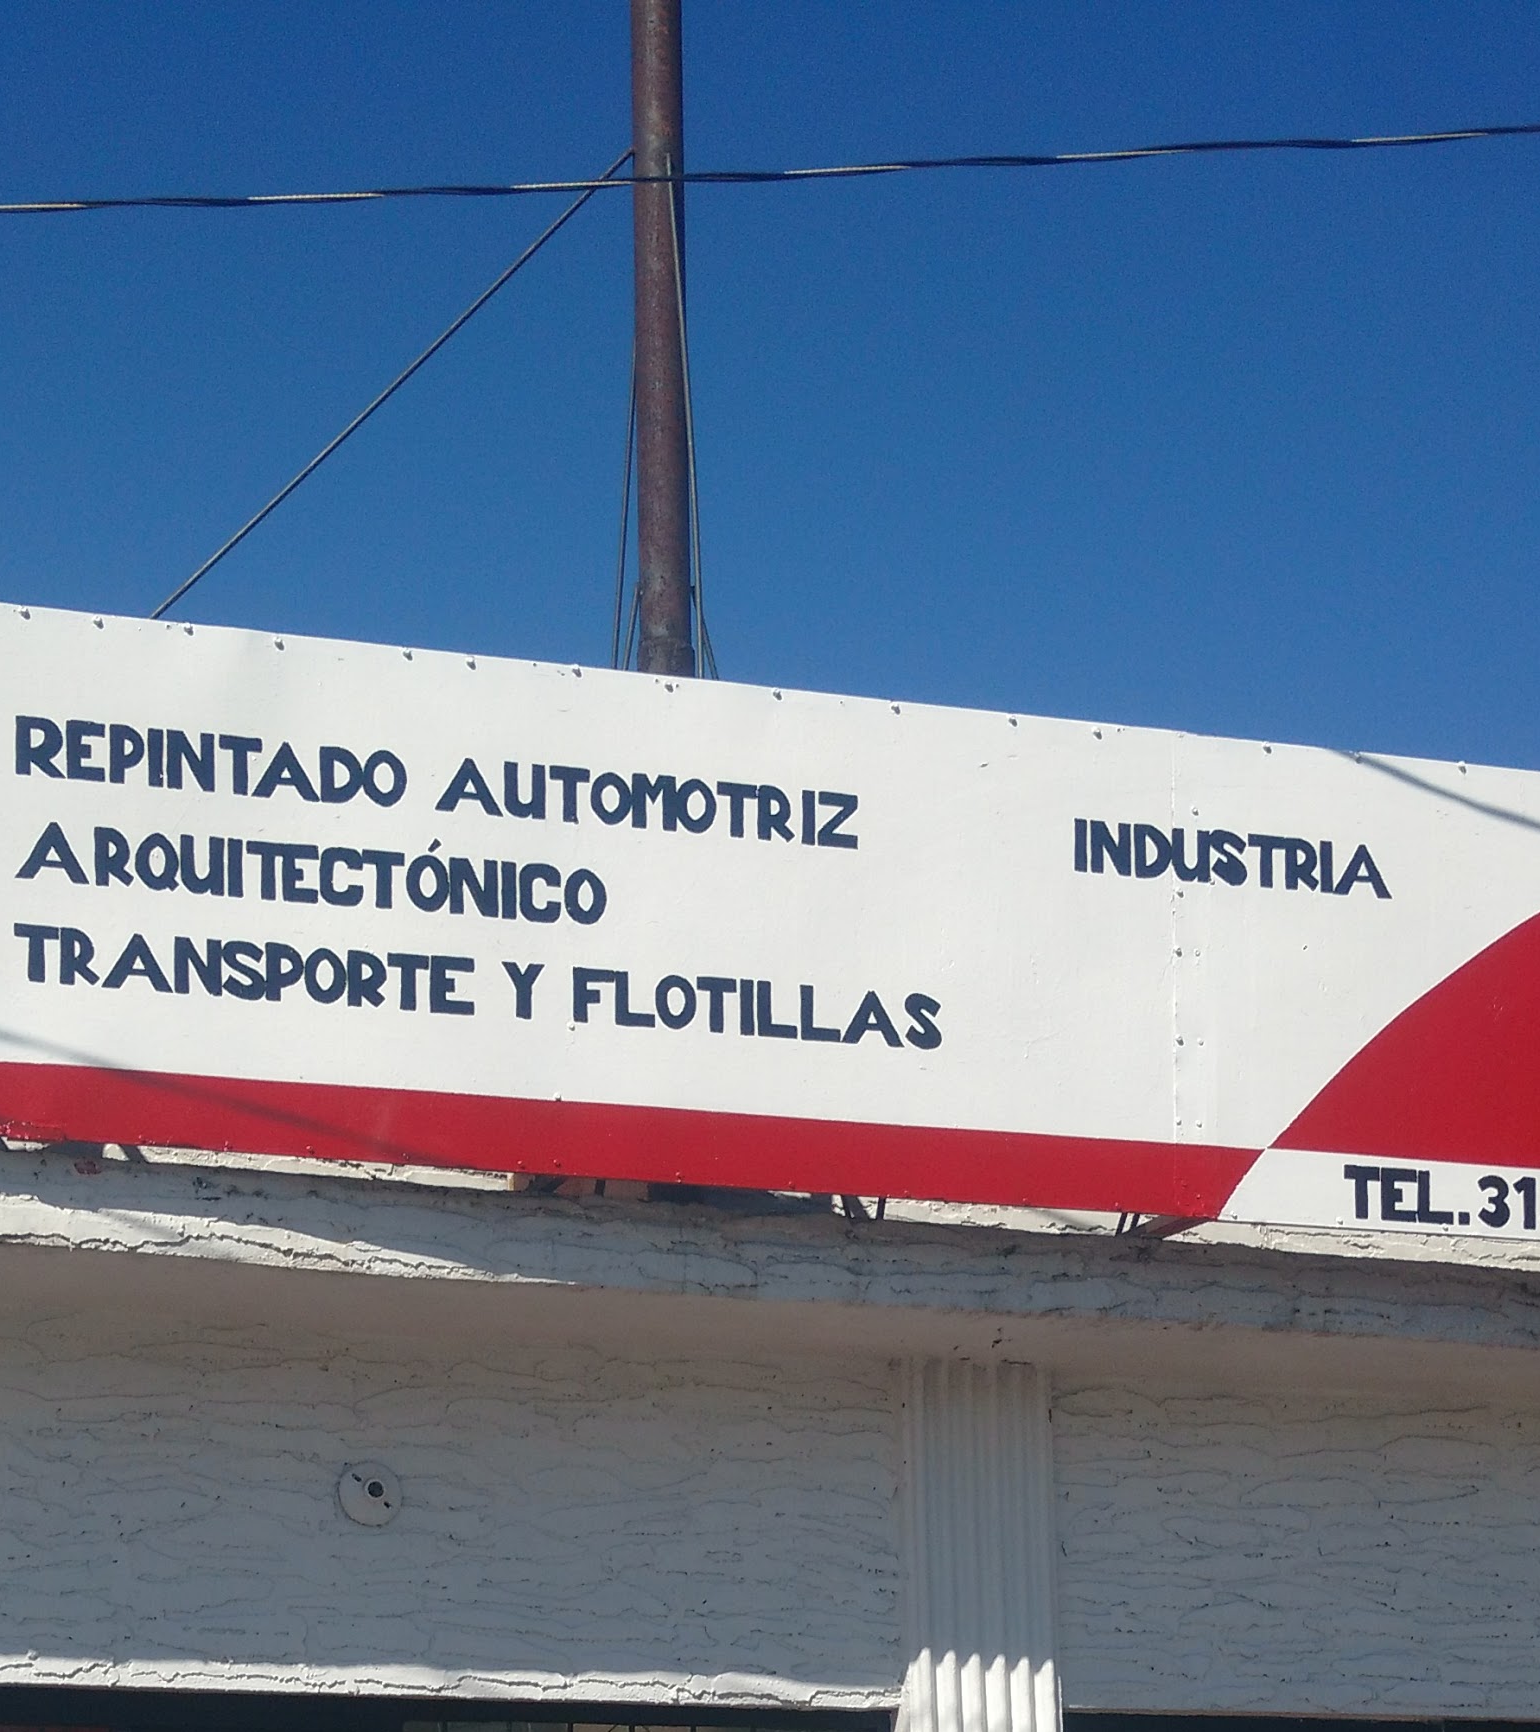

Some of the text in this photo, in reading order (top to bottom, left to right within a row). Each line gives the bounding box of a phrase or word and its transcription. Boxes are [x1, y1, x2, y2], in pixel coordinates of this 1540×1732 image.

[15, 715, 859, 850] REPINTADO AUTOMOTRIZ
[15, 821, 608, 925] ARQUITECTÓNICO
[1074, 817, 1393, 900] INDUSTRIA
[13, 922, 943, 1050] TRANSPORTE Y FLOTILLAS
